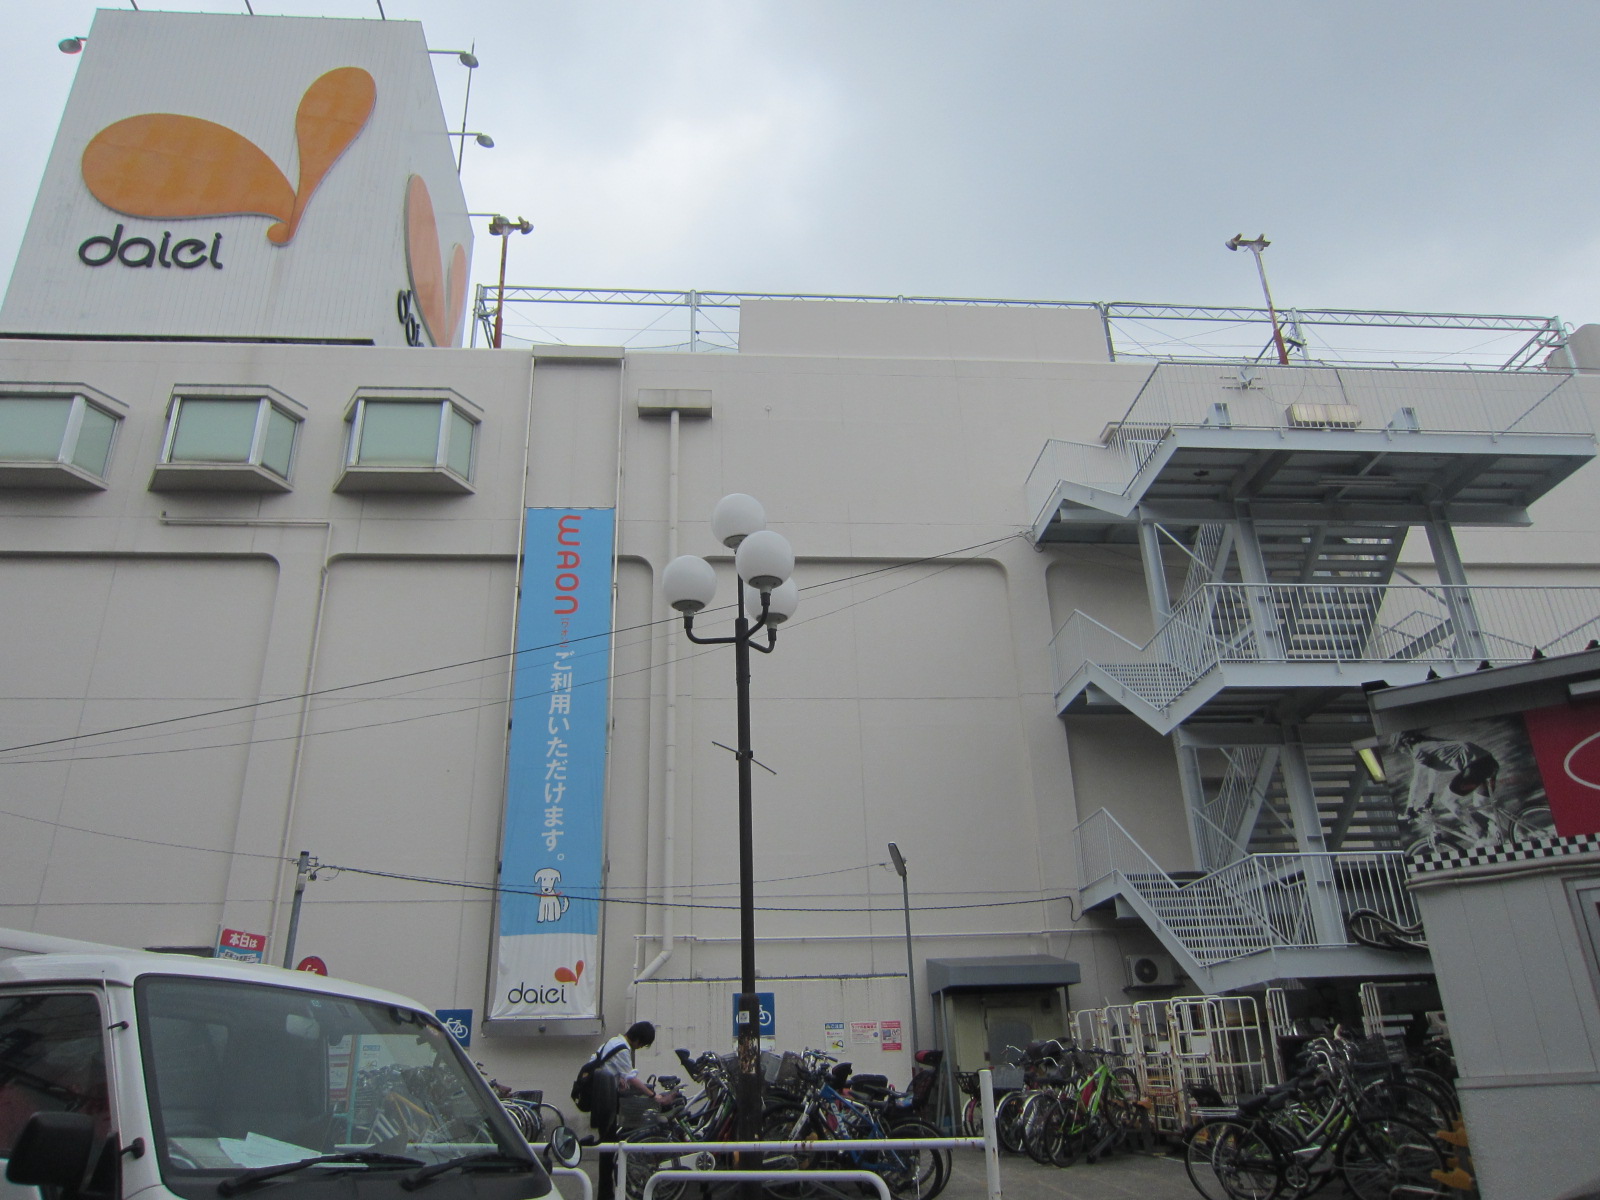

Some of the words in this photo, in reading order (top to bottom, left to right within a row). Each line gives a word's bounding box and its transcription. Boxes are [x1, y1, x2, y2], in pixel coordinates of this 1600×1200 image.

[78, 224, 223, 269] daiei
[541, 650, 575, 861] ご利用いただけます。
[229, 932, 258, 949] 本日は
[507, 982, 567, 1004] daiei
